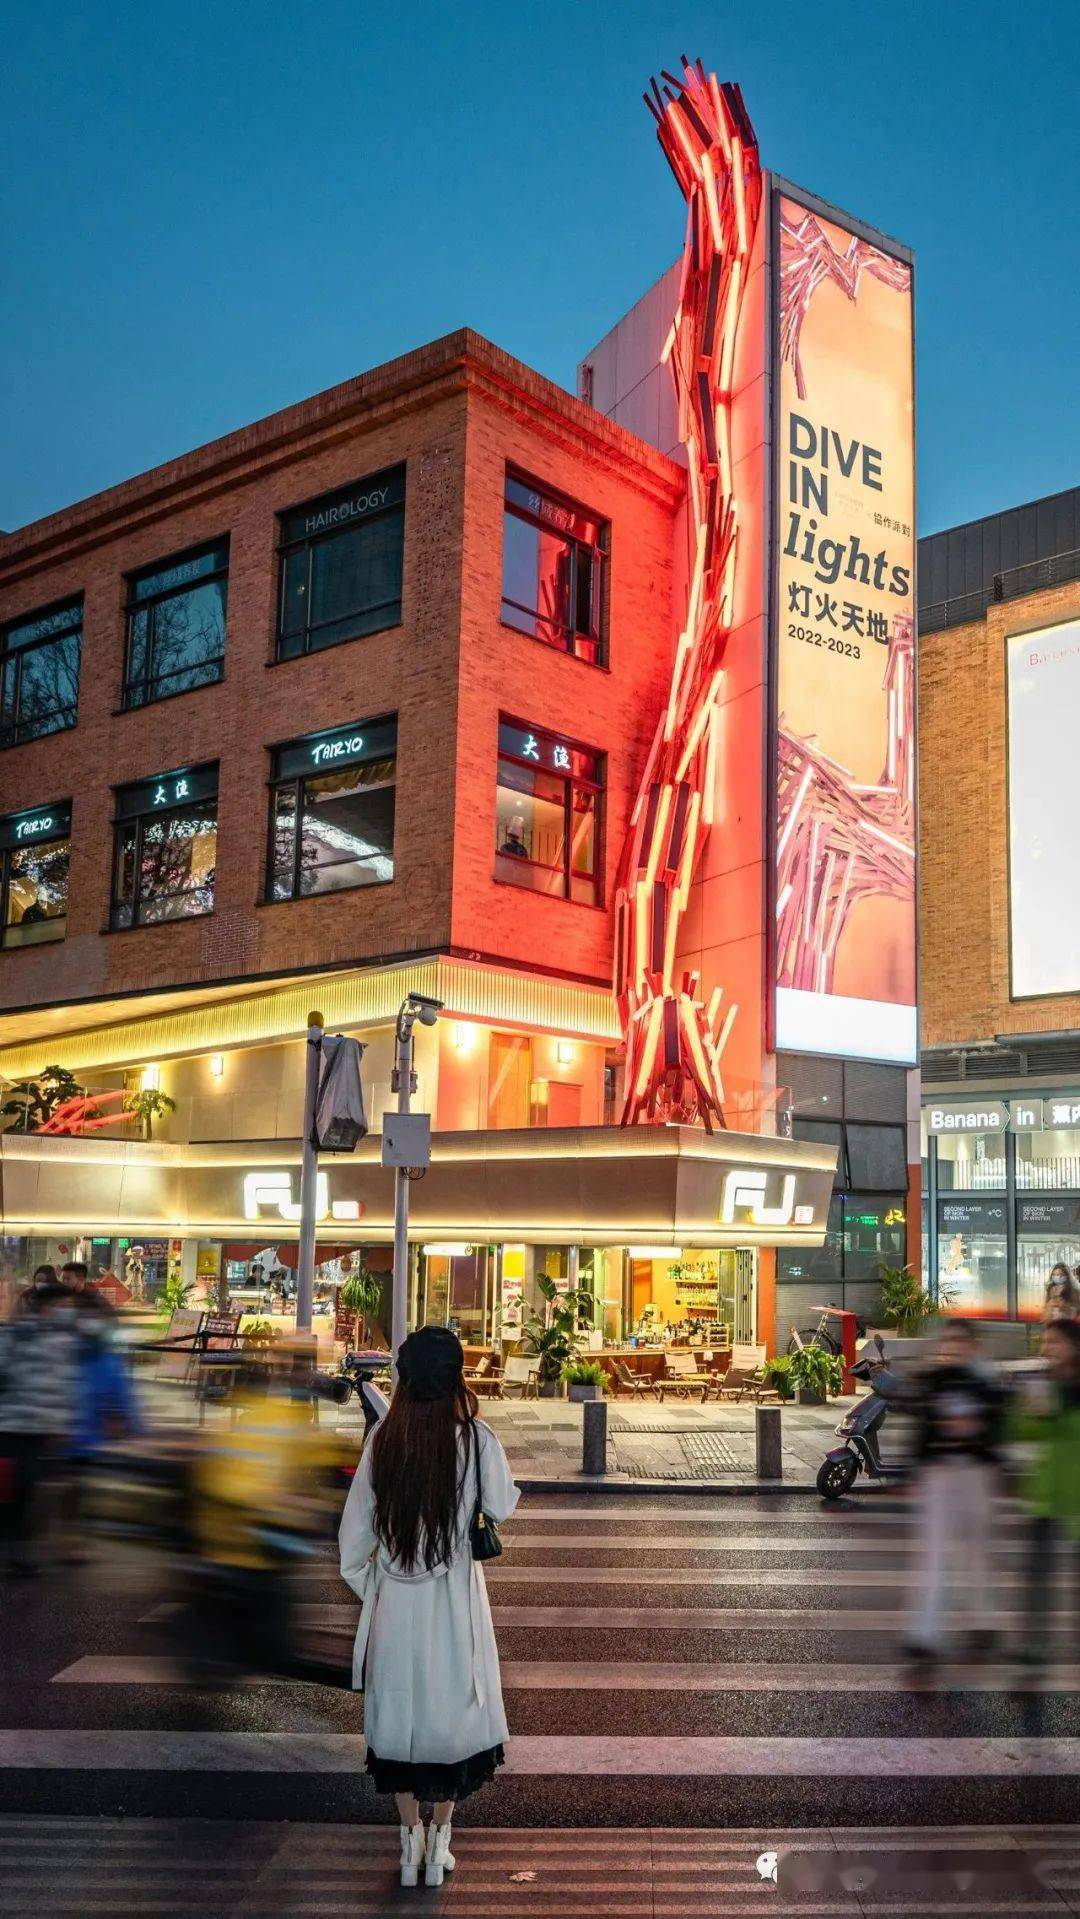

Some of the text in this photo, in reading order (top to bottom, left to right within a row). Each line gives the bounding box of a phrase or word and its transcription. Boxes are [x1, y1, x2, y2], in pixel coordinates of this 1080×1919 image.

[789, 411, 883, 492] DIVE
[305, 487, 388, 533] HAIROLOGY
[789, 460, 828, 516] IN
[783, 511, 910, 597] lights
[788, 581, 889, 645] 灯火天地
[788, 624, 861, 659] 2022-2023
[311, 737, 363, 764] TAIRYO
[931, 1110, 999, 1129] Banana
[1016, 1106, 1035, 1125] in
